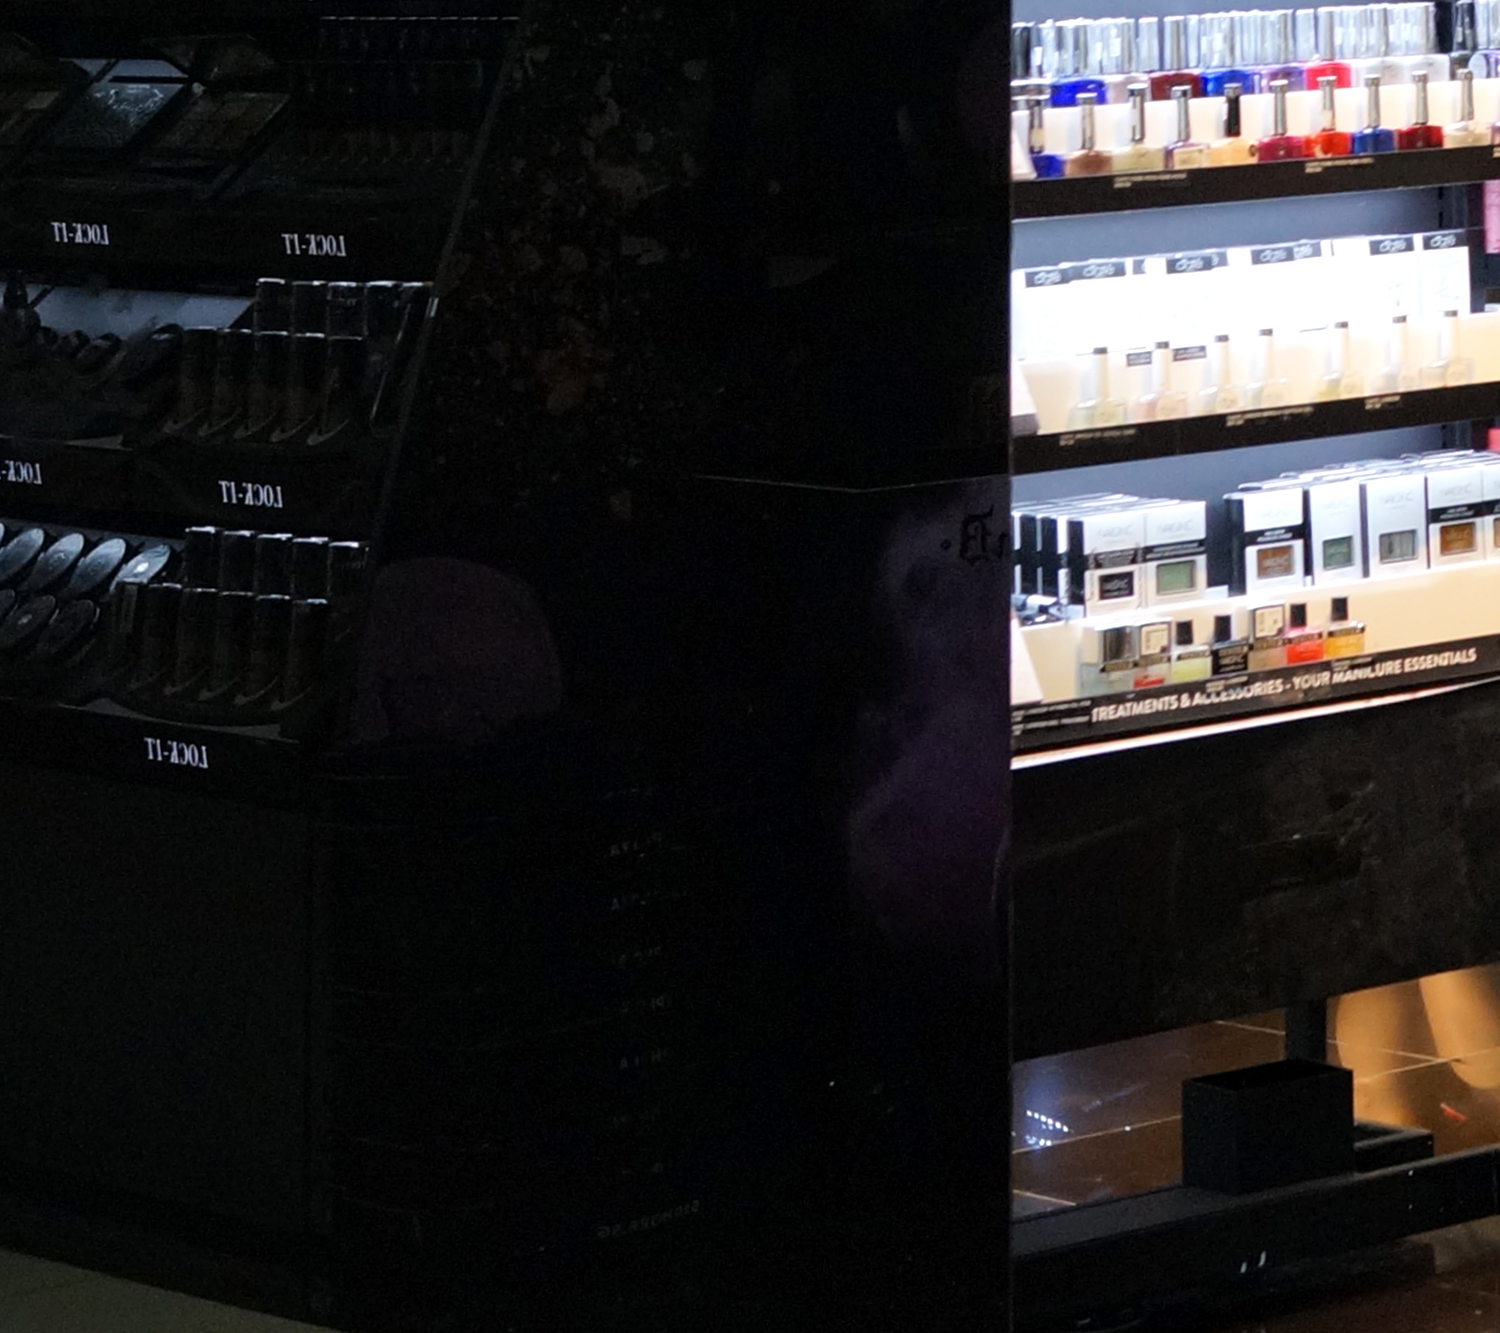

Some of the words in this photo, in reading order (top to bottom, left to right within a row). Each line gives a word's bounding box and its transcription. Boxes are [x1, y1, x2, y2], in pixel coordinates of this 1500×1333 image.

[1090, 694, 1178, 723] TREATMENTS
[1292, 667, 1331, 691] YOUR
[1403, 647, 1478, 674] ESSENTIALS
